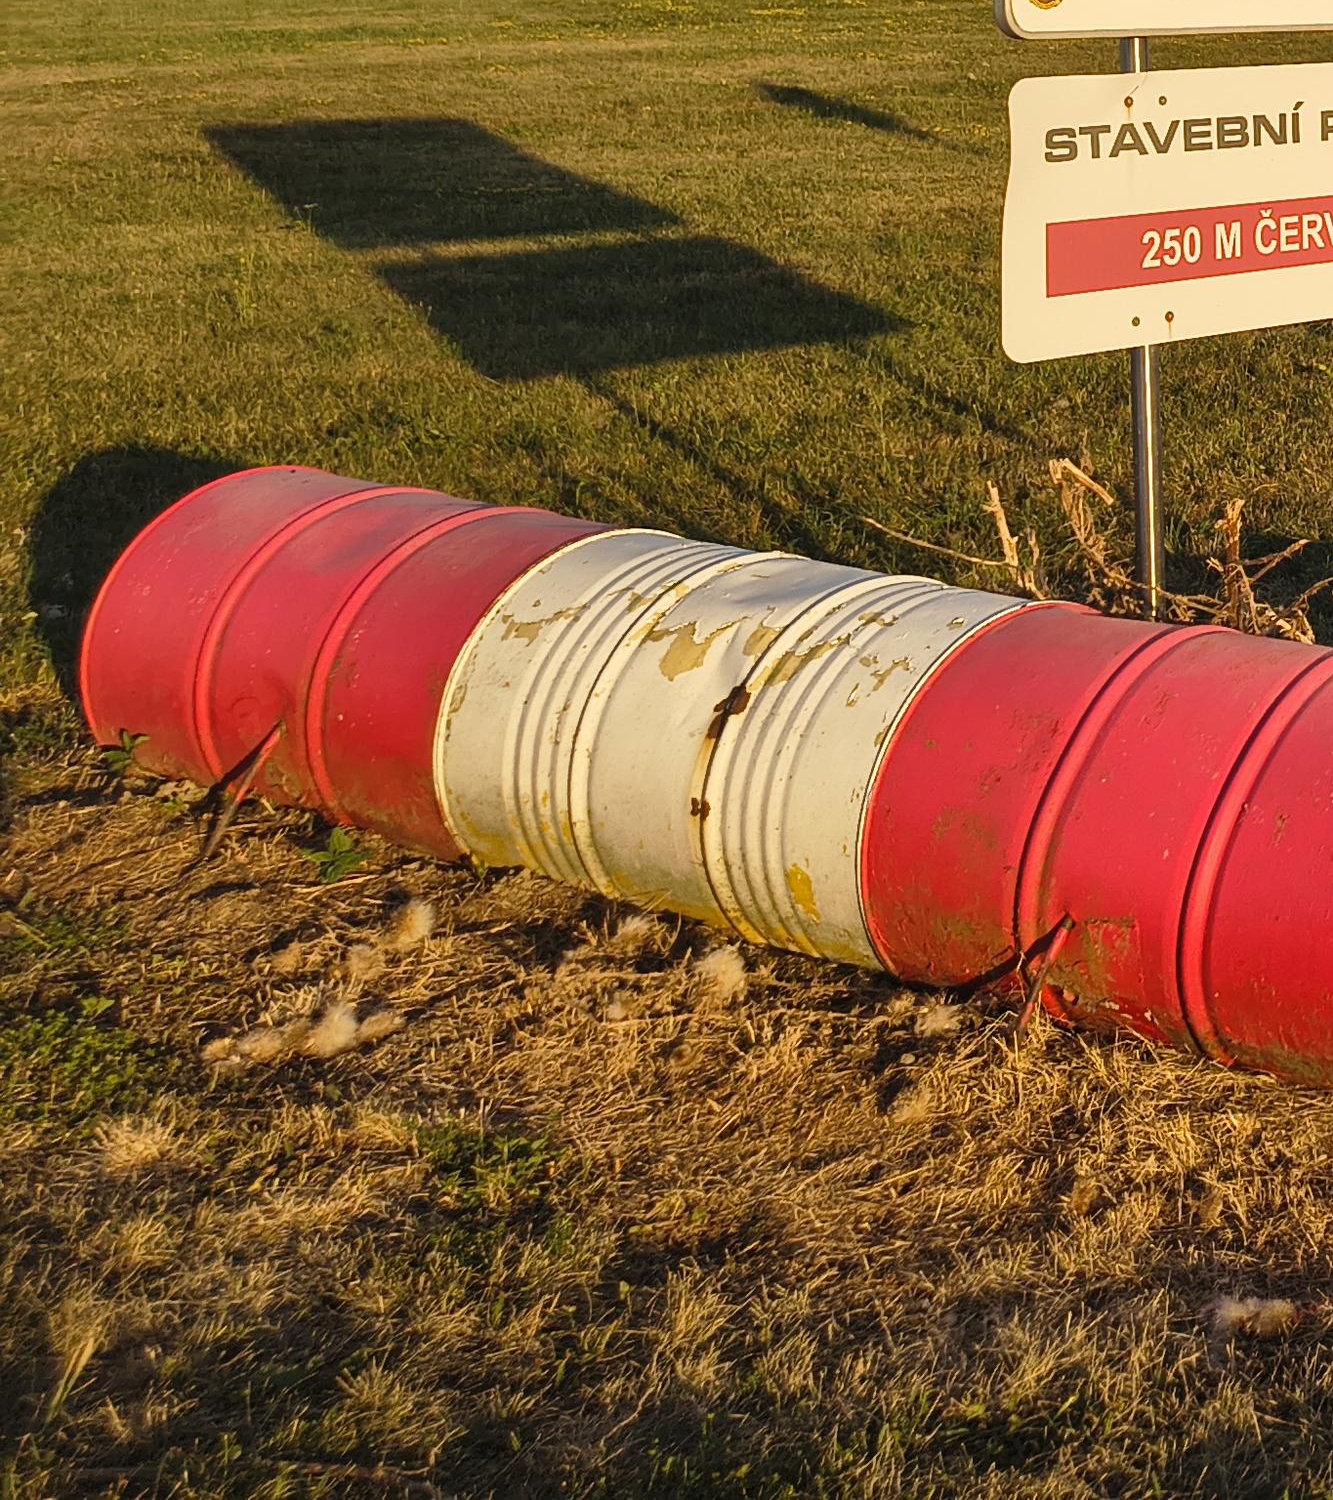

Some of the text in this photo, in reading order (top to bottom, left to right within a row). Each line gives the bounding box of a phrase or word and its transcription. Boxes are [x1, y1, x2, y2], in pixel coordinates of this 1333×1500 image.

[1044, 101, 1302, 162] STAVEBNÍ
[1140, 226, 1201, 268] 250
[1215, 224, 1242, 259] M
